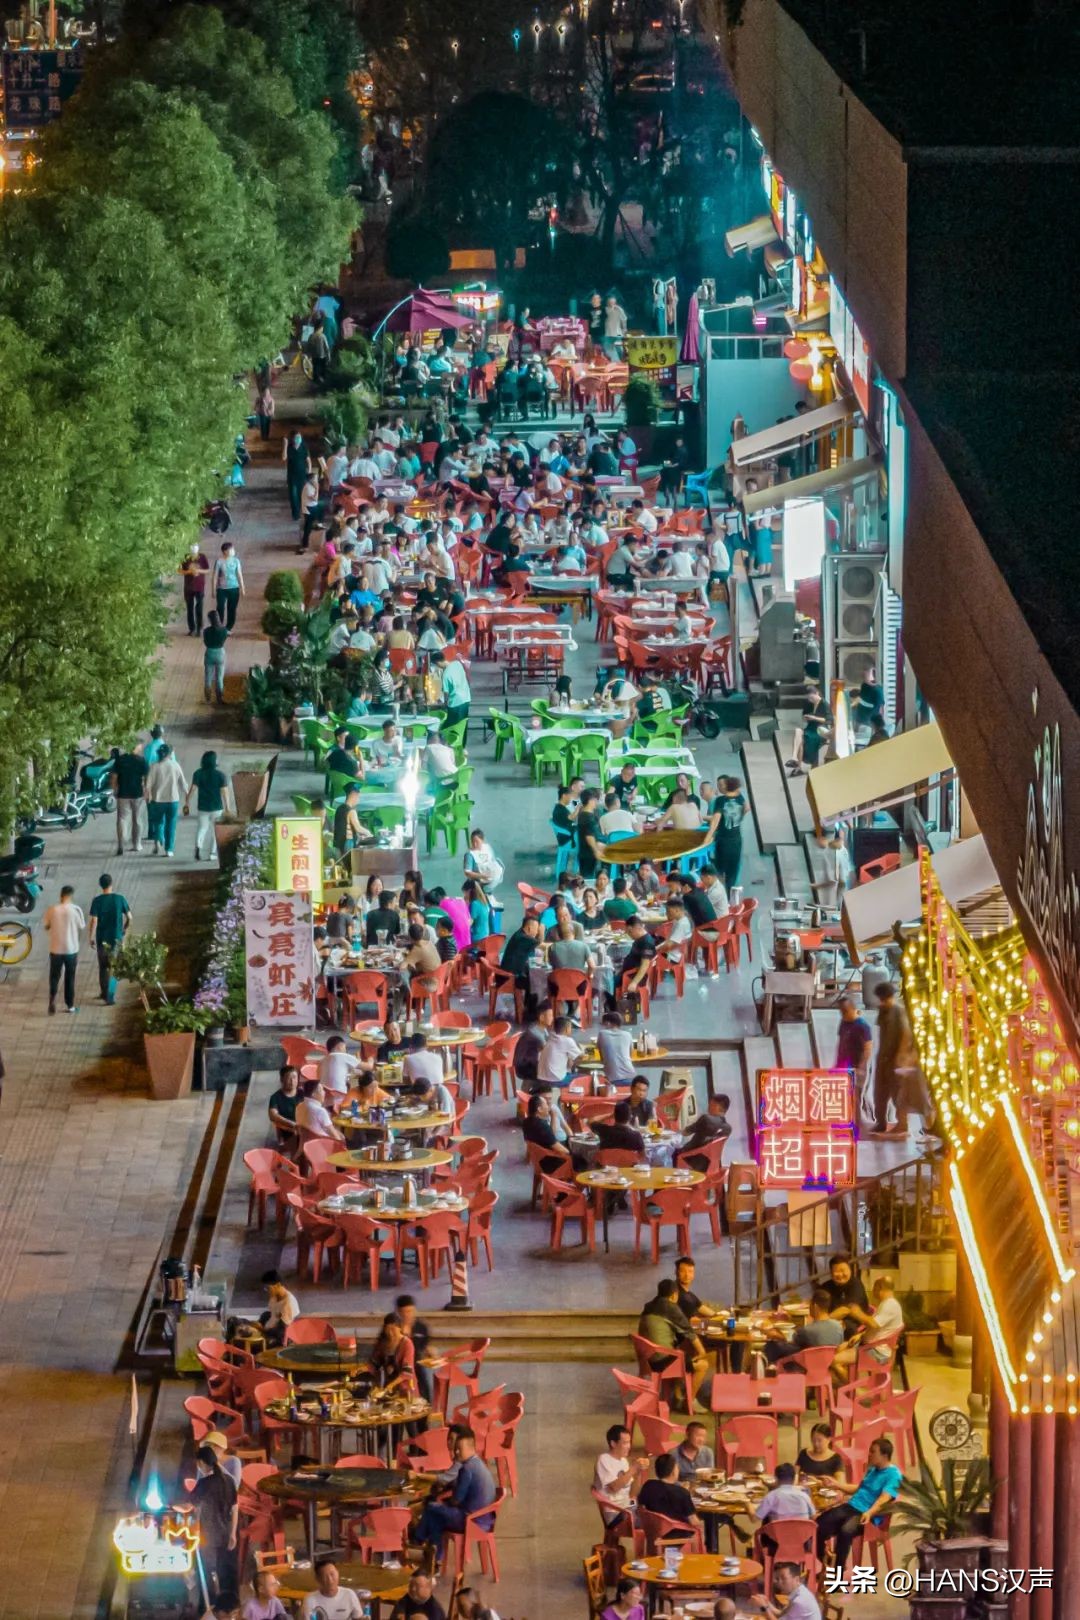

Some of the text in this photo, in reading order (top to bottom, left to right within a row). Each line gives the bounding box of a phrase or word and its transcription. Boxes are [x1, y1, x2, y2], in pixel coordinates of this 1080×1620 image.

[291, 833, 310, 890] 生煎包
[267, 901, 297, 1018] 亮亮虾庄
[764, 1075, 850, 1122] 烟酒
[762, 1129, 852, 1183] 超市
